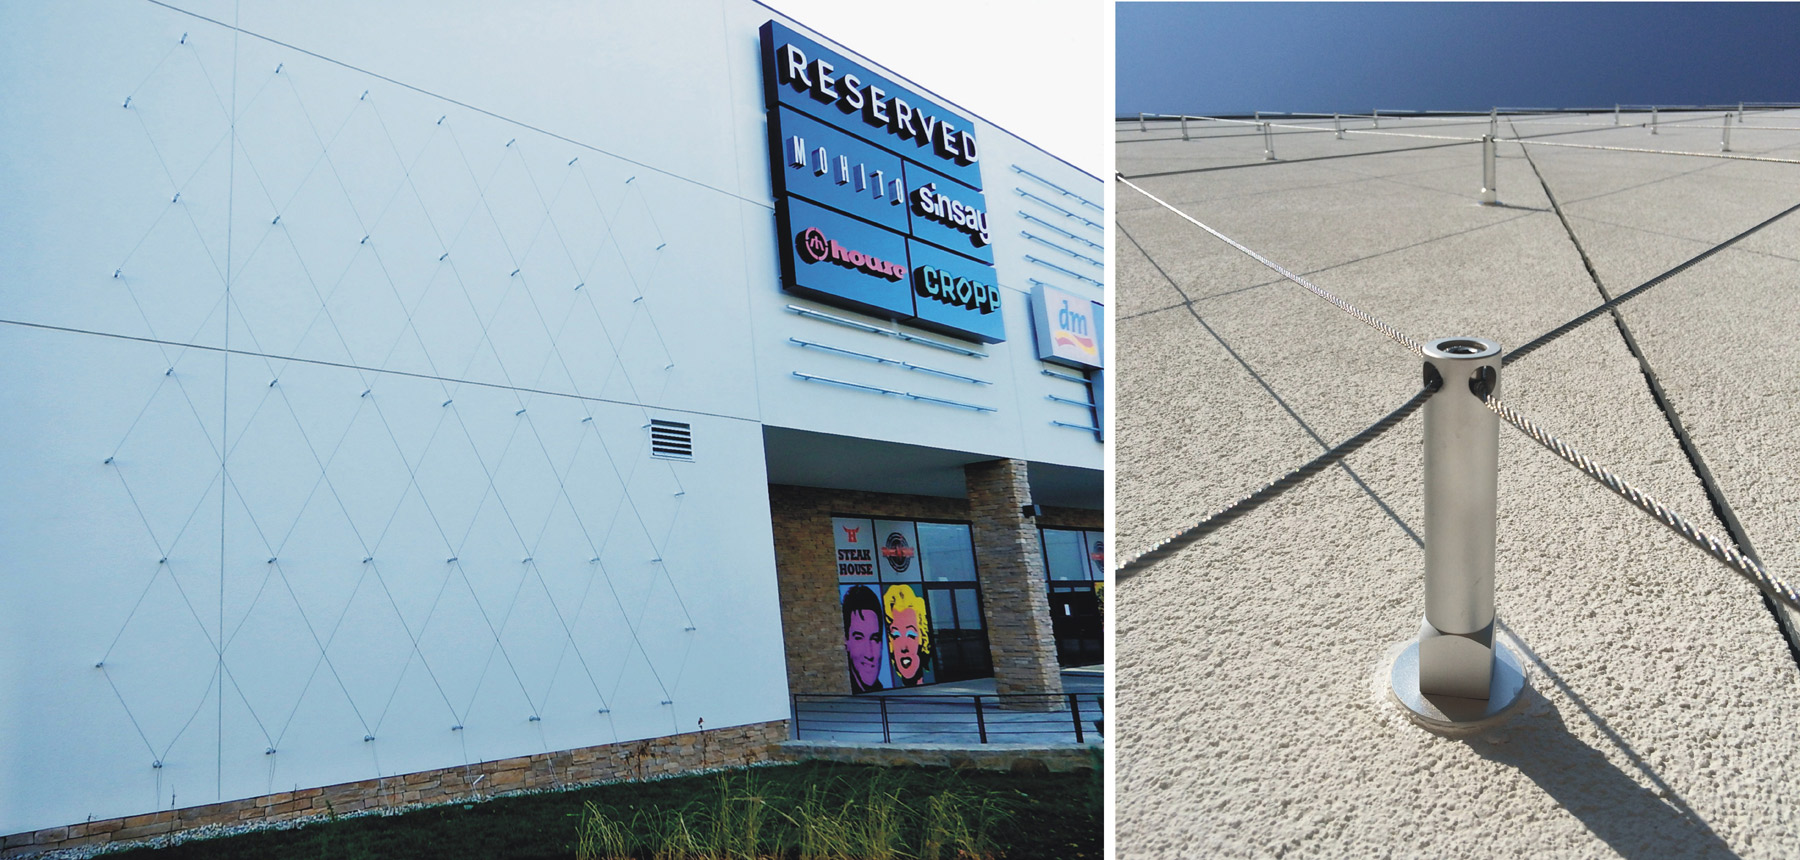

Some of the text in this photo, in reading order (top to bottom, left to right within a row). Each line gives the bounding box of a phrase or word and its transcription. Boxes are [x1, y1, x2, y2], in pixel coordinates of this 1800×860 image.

[787, 43, 979, 163] RESERVED
[789, 135, 904, 205] MOHITO
[919, 182, 992, 244] sinsay
[830, 239, 908, 280] house
[923, 264, 1001, 312] CROPP
[1058, 299, 1088, 336] dm
[838, 549, 872, 561] STEAK
[839, 563, 873, 576] HOUSE
